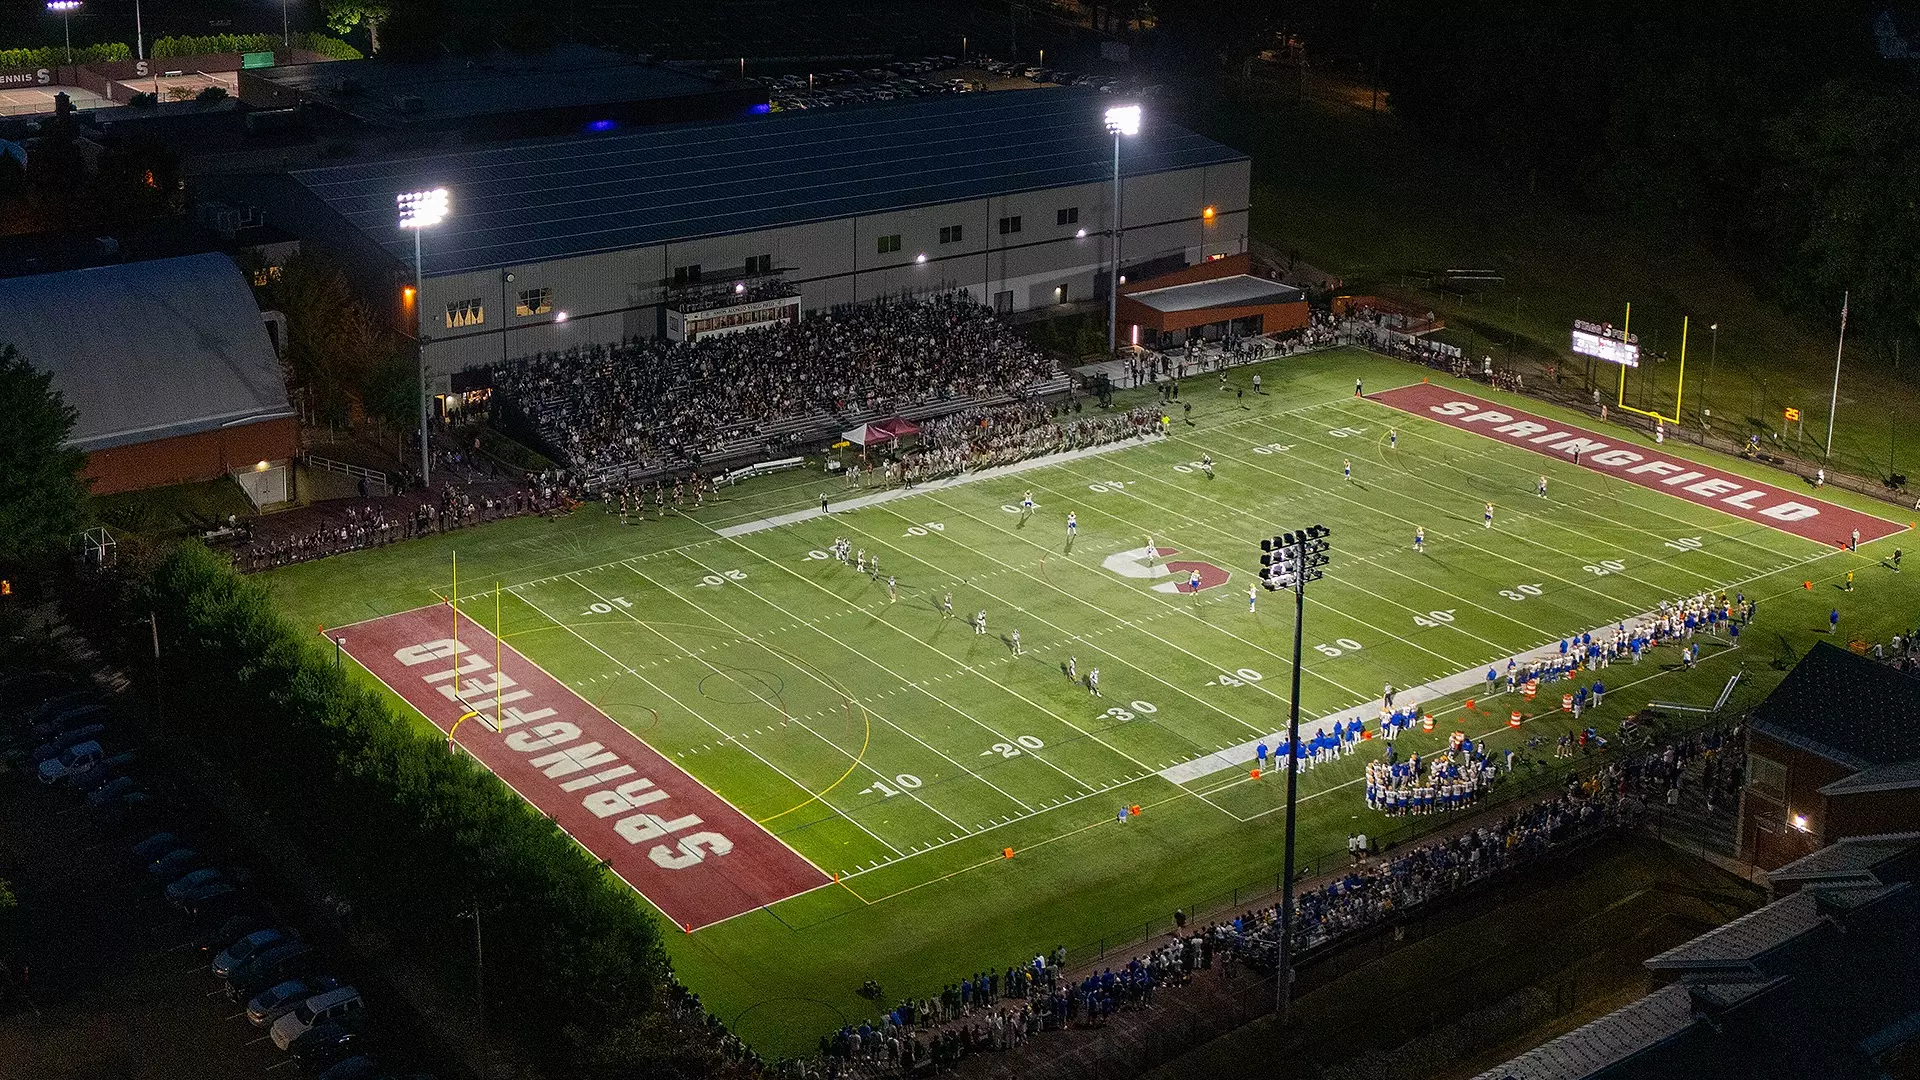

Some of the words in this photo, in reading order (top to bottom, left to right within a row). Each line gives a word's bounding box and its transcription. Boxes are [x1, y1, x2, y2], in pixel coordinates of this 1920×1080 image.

[37, 68, 50, 84] S
[136, 61, 148, 76] S
[1785, 407, 1798, 420] 25
[1328, 427, 1361, 438] 10
[1253, 443, 1289, 454] 20
[1430, 401, 1820, 521] SPRINGFIELD
[1088, 480, 1124, 492] 40
[907, 522, 944, 536] 40
[1664, 538, 1702, 551] 10
[1102, 546, 1232, 594] S
[1583, 560, 1625, 576] 20
[703, 570, 748, 585] 20
[1499, 584, 1542, 601] 30
[590, 596, 633, 613] 10
[1413, 610, 1455, 627] 40
[1314, 638, 1362, 657] 50
[1219, 668, 1263, 687] 40
[1107, 700, 1157, 720] 30
[392, 638, 734, 870] SPRINGFIELD
[992, 735, 1044, 758] 20
[872, 773, 922, 797] 10
